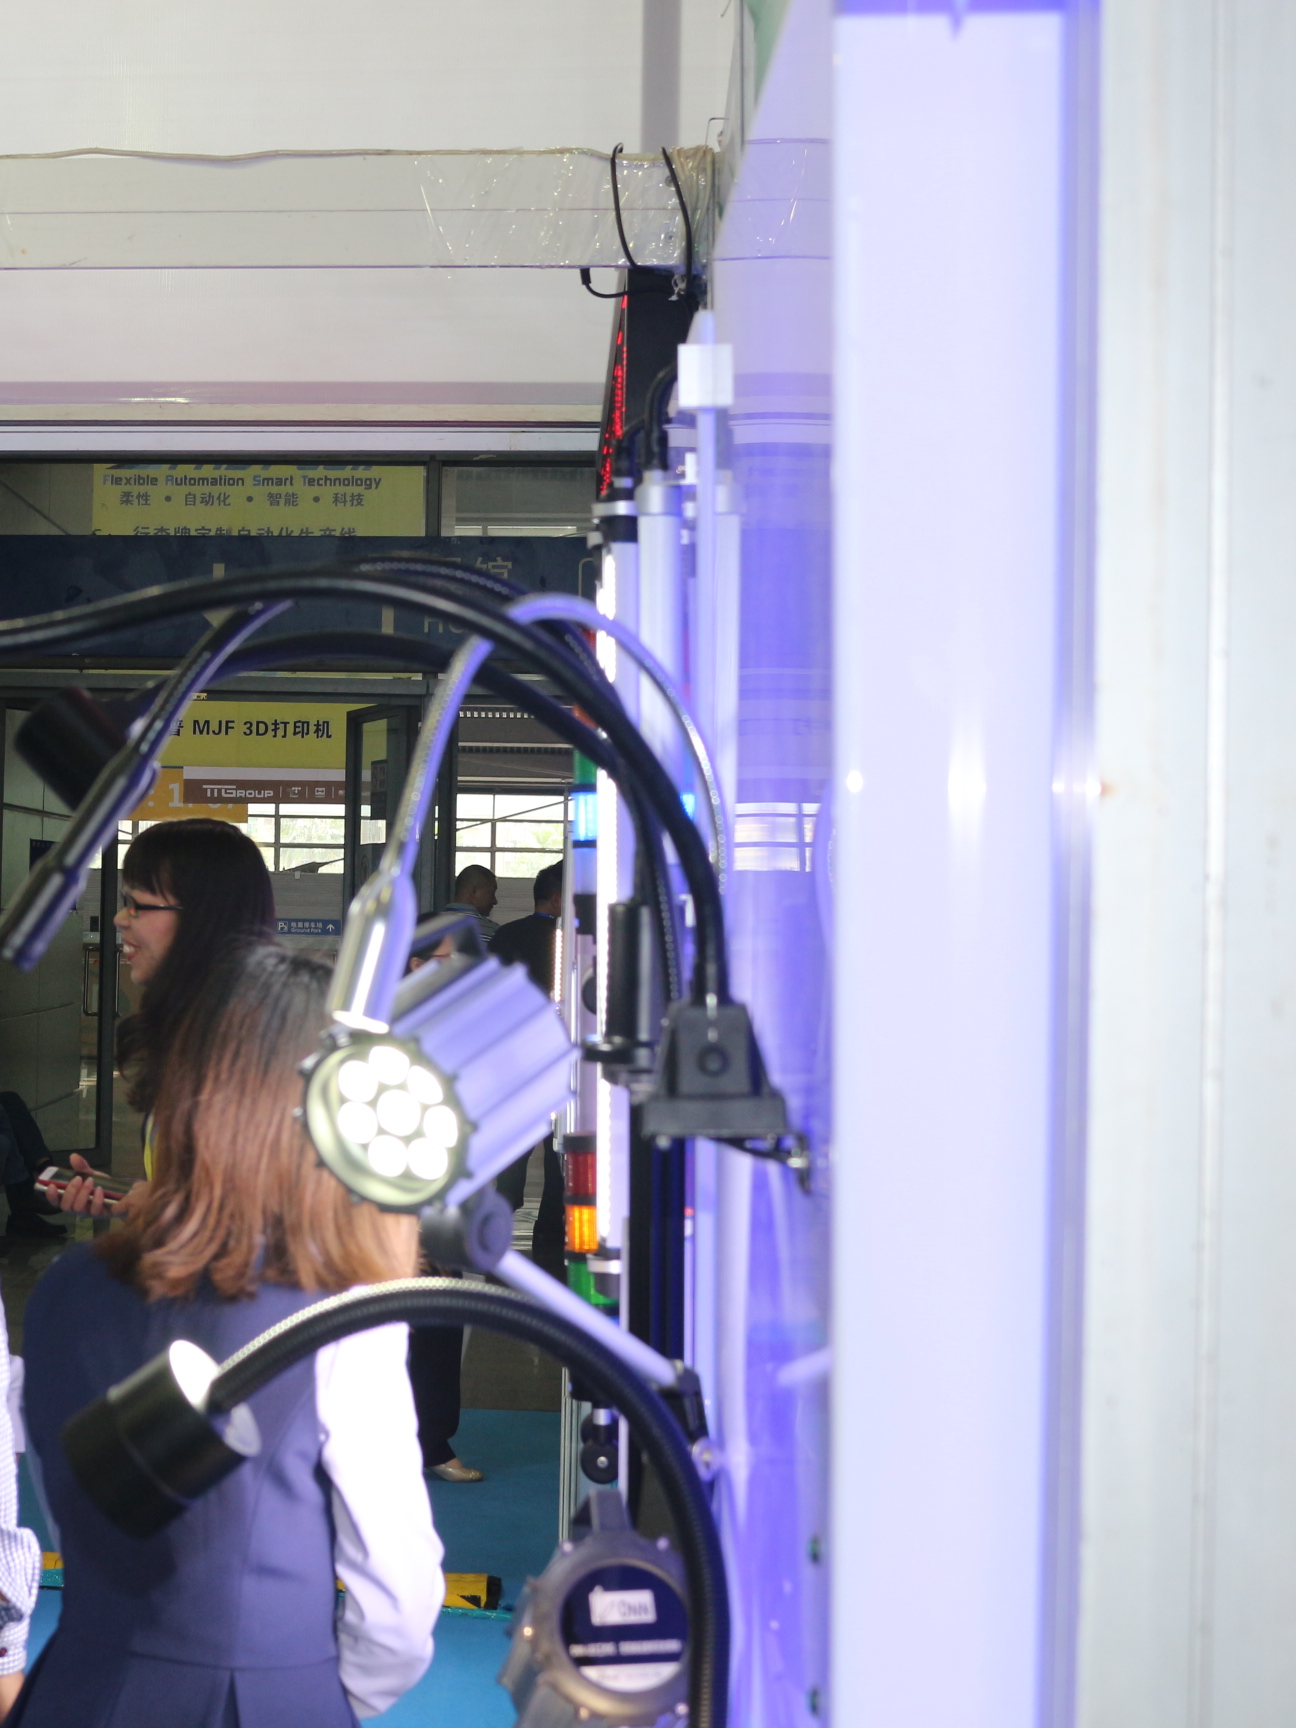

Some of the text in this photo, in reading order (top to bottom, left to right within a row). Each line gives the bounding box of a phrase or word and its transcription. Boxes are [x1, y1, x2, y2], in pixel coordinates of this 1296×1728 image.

[102, 474, 382, 490] Flexible Automation Smart Technology
[119, 491, 365, 507] 柔性 自动化 智能 科技
[192, 719, 236, 736] MJF
[242, 718, 333, 739] 3D打印机
